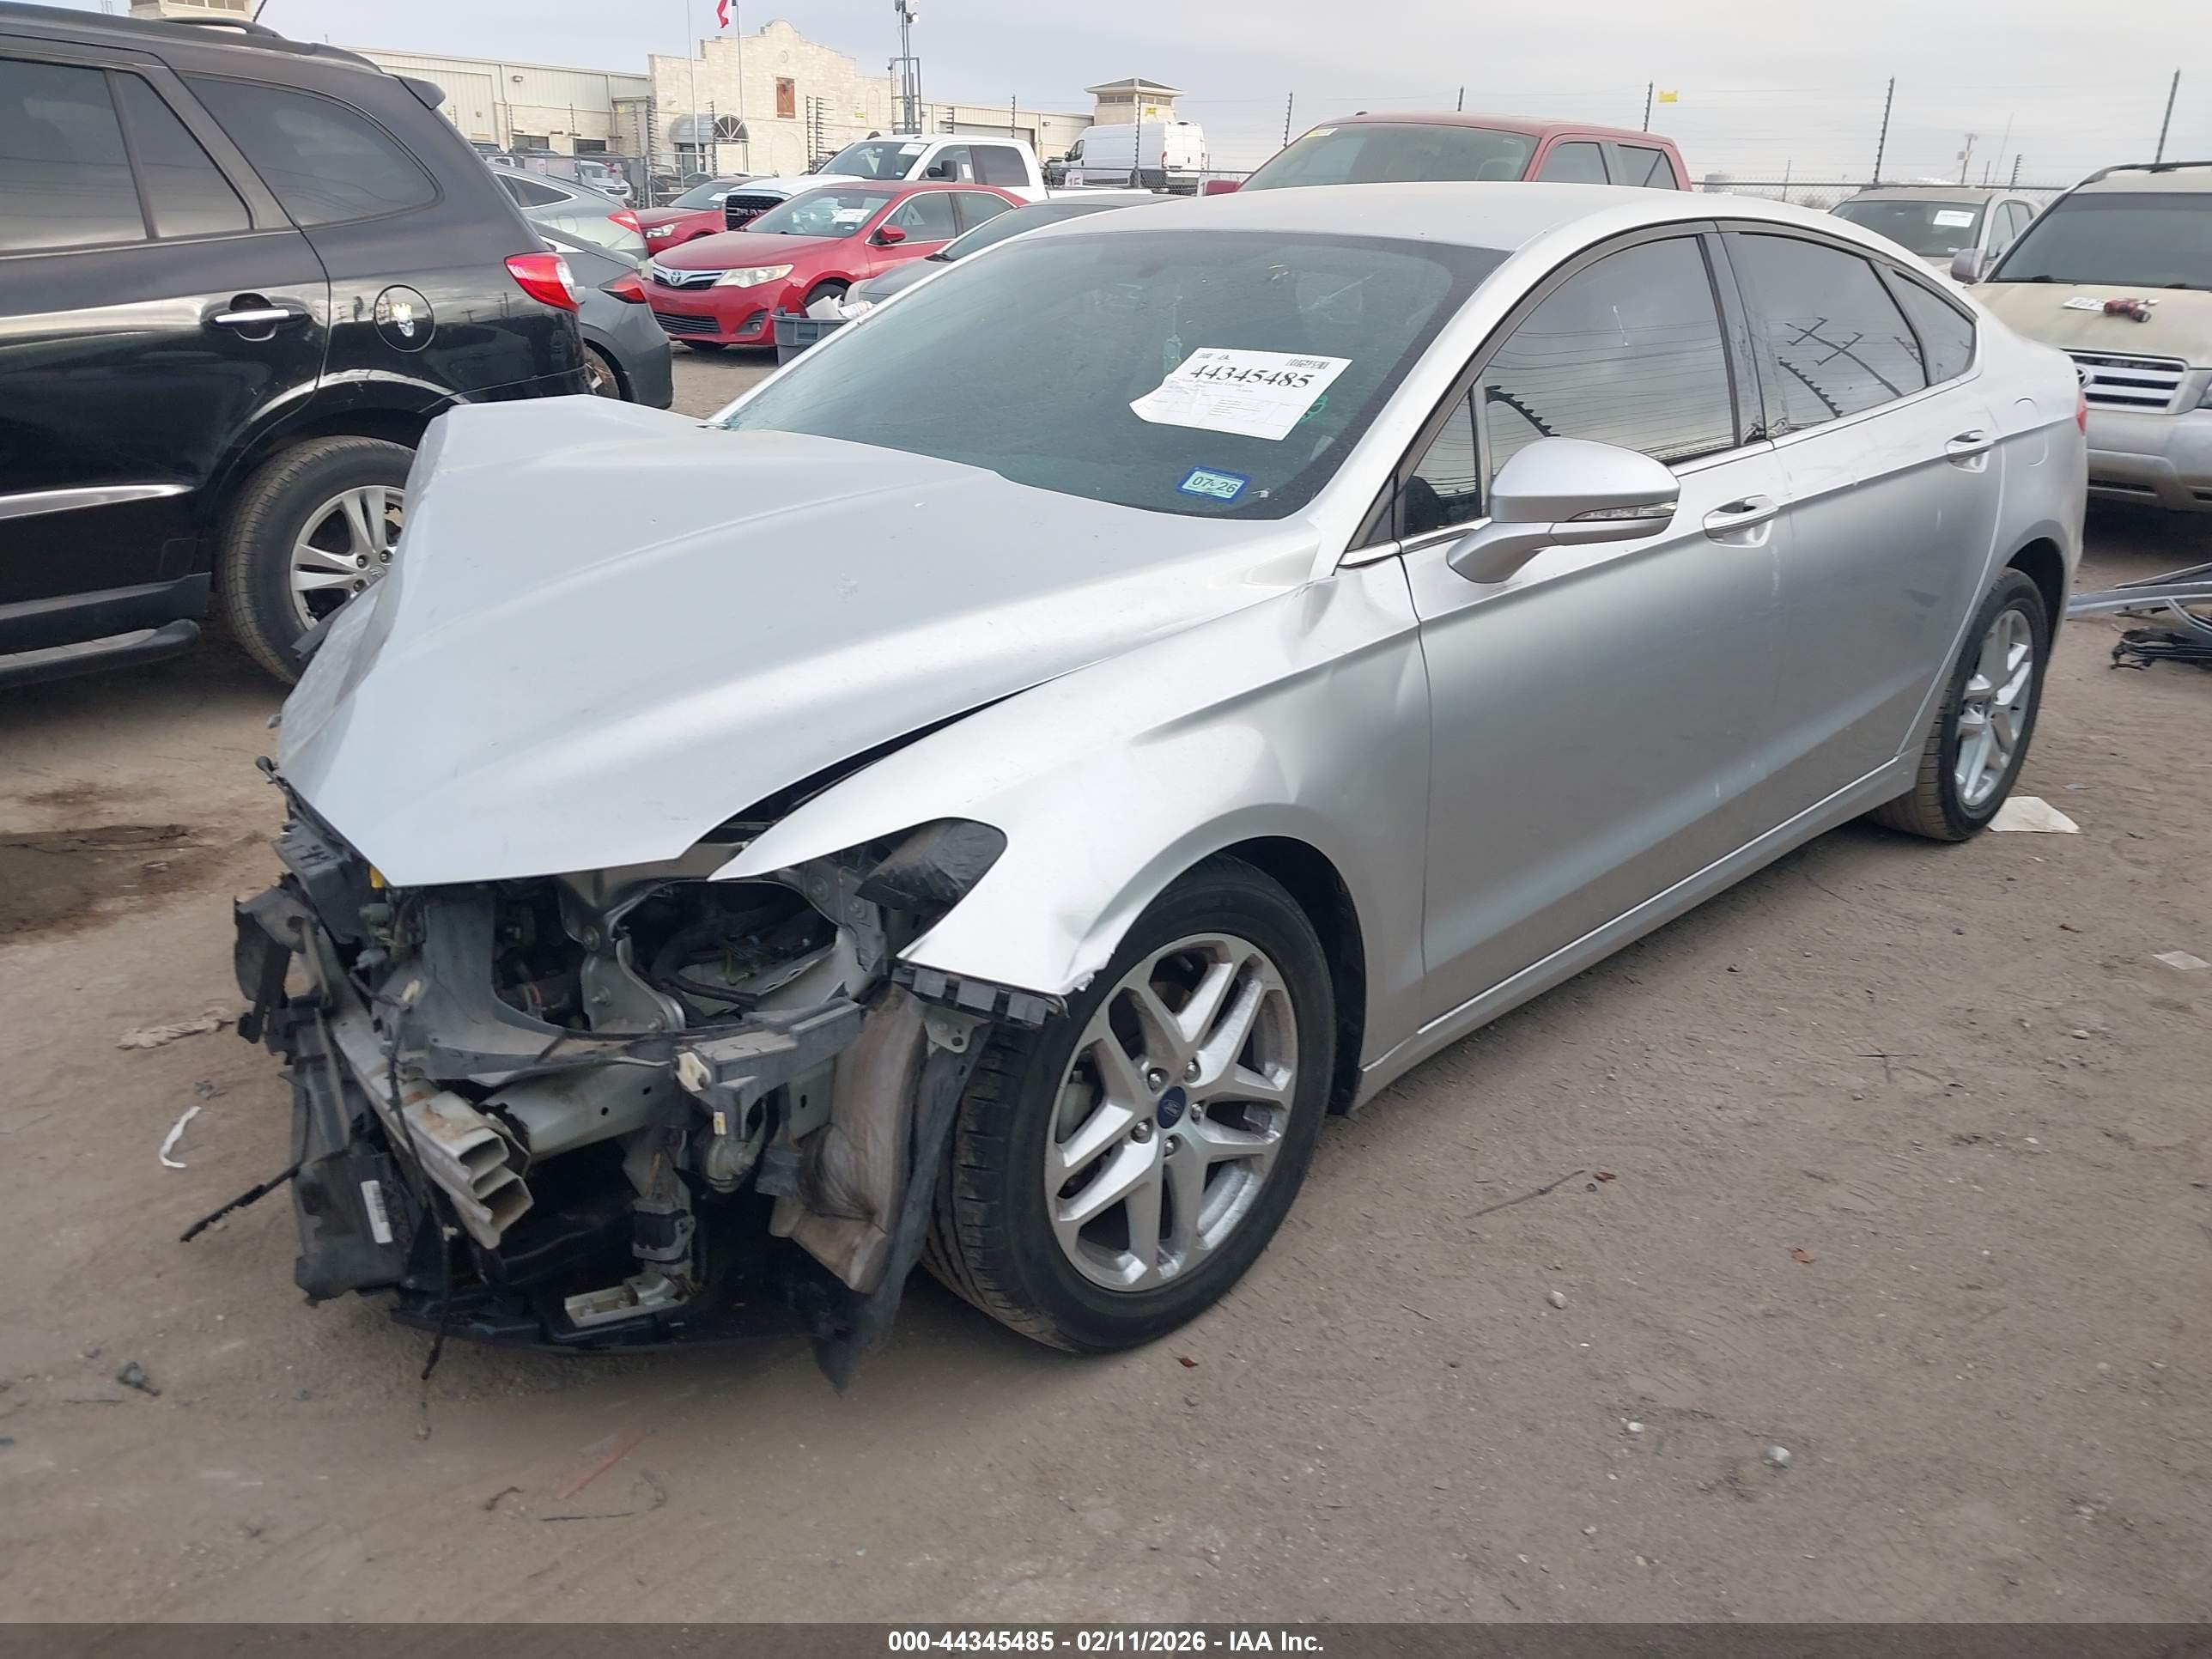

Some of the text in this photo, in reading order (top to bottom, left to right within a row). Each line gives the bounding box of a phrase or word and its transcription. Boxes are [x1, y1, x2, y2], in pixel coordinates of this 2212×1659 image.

[1190, 365, 1315, 388] 44345485
[1192, 477, 1238, 493] 07 26
